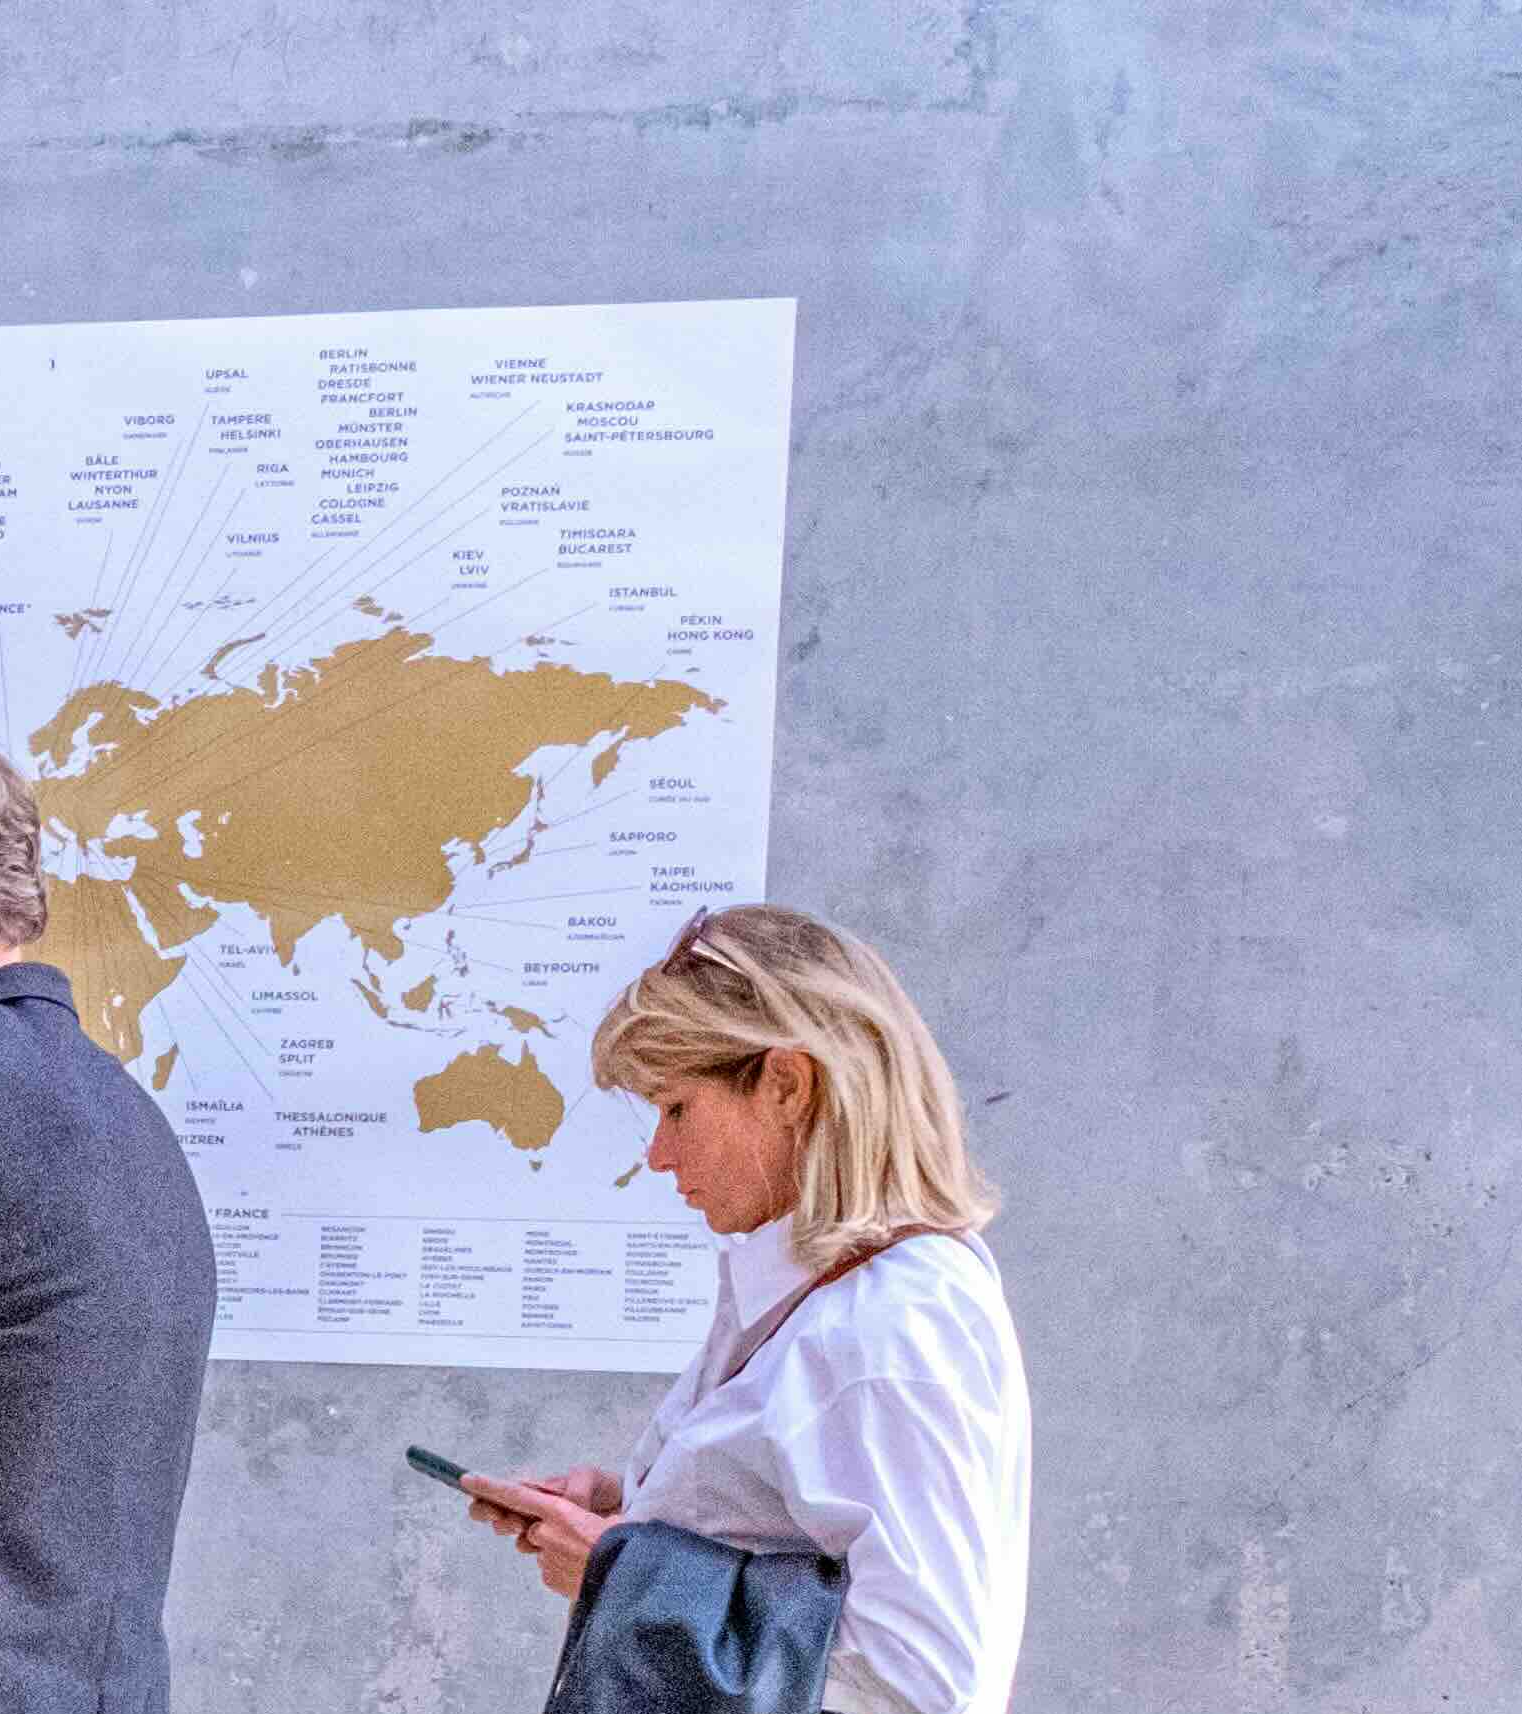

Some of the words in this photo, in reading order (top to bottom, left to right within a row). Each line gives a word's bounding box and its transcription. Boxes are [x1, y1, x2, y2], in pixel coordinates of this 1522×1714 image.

[319, 350, 368, 360] BERLIN
[329, 363, 416, 374] RATISBONNE
[495, 359, 546, 368] VIENNE
[206, 369, 248, 379] UPSAL
[471, 374, 525, 384] WIENER
[531, 372, 604, 383] NEUSTADT
[318, 379, 371, 389] DRESDE
[321, 393, 403, 404] FRANCFORT
[369, 408, 418, 418] BERLIN
[124, 415, 175, 426] VIBORG
[211, 414, 272, 425] TAMPERE
[577, 417, 638, 426] MOSCOU
[337, 420, 402, 433] MÜNSTER
[220, 430, 281, 440] HELSINKI
[565, 430, 714, 443] SAINT-PÉTERSBOURG
[315, 438, 408, 449] OBERHAUSEN
[85, 454, 119, 466] BÂLE
[329, 453, 408, 464] HAMBOURG
[257, 464, 289, 473] RIGA
[70, 469, 158, 481] WINTERTHUR
[321, 469, 374, 479] MUNICH
[95, 485, 132, 494] NYON
[347, 483, 399, 494] LEIPZIG
[68, 500, 138, 510] LAUSANNE
[319, 499, 384, 509] COLOGNE
[501, 501, 590, 512] VRATISLAVIE
[311, 514, 361, 524] CASSEL
[227, 533, 279, 544] VILNIUS
[558, 545, 632, 555] BUCAREST
[453, 551, 484, 560] KIEV
[459, 566, 489, 575] LVIV
[609, 588, 677, 598] ISTANBUL
[680, 615, 722, 625] PÉKIN
[668, 631, 708, 641] HONG
[714, 631, 753, 641] KONG
[649, 776, 695, 789] SÉOUL
[609, 832, 677, 842] SAPPORO
[651, 867, 695, 877] TAIPEI
[567, 917, 616, 927] BAKOU
[523, 962, 601, 975] BEYROUTH
[251, 991, 318, 1001] LIMASSOL
[281, 1040, 334, 1048] ZAGREB
[280, 1055, 315, 1064] SPLIT
[276, 1113, 387, 1122] THESSALONIQUE
[176, 1135, 224, 1145] RIZREN
